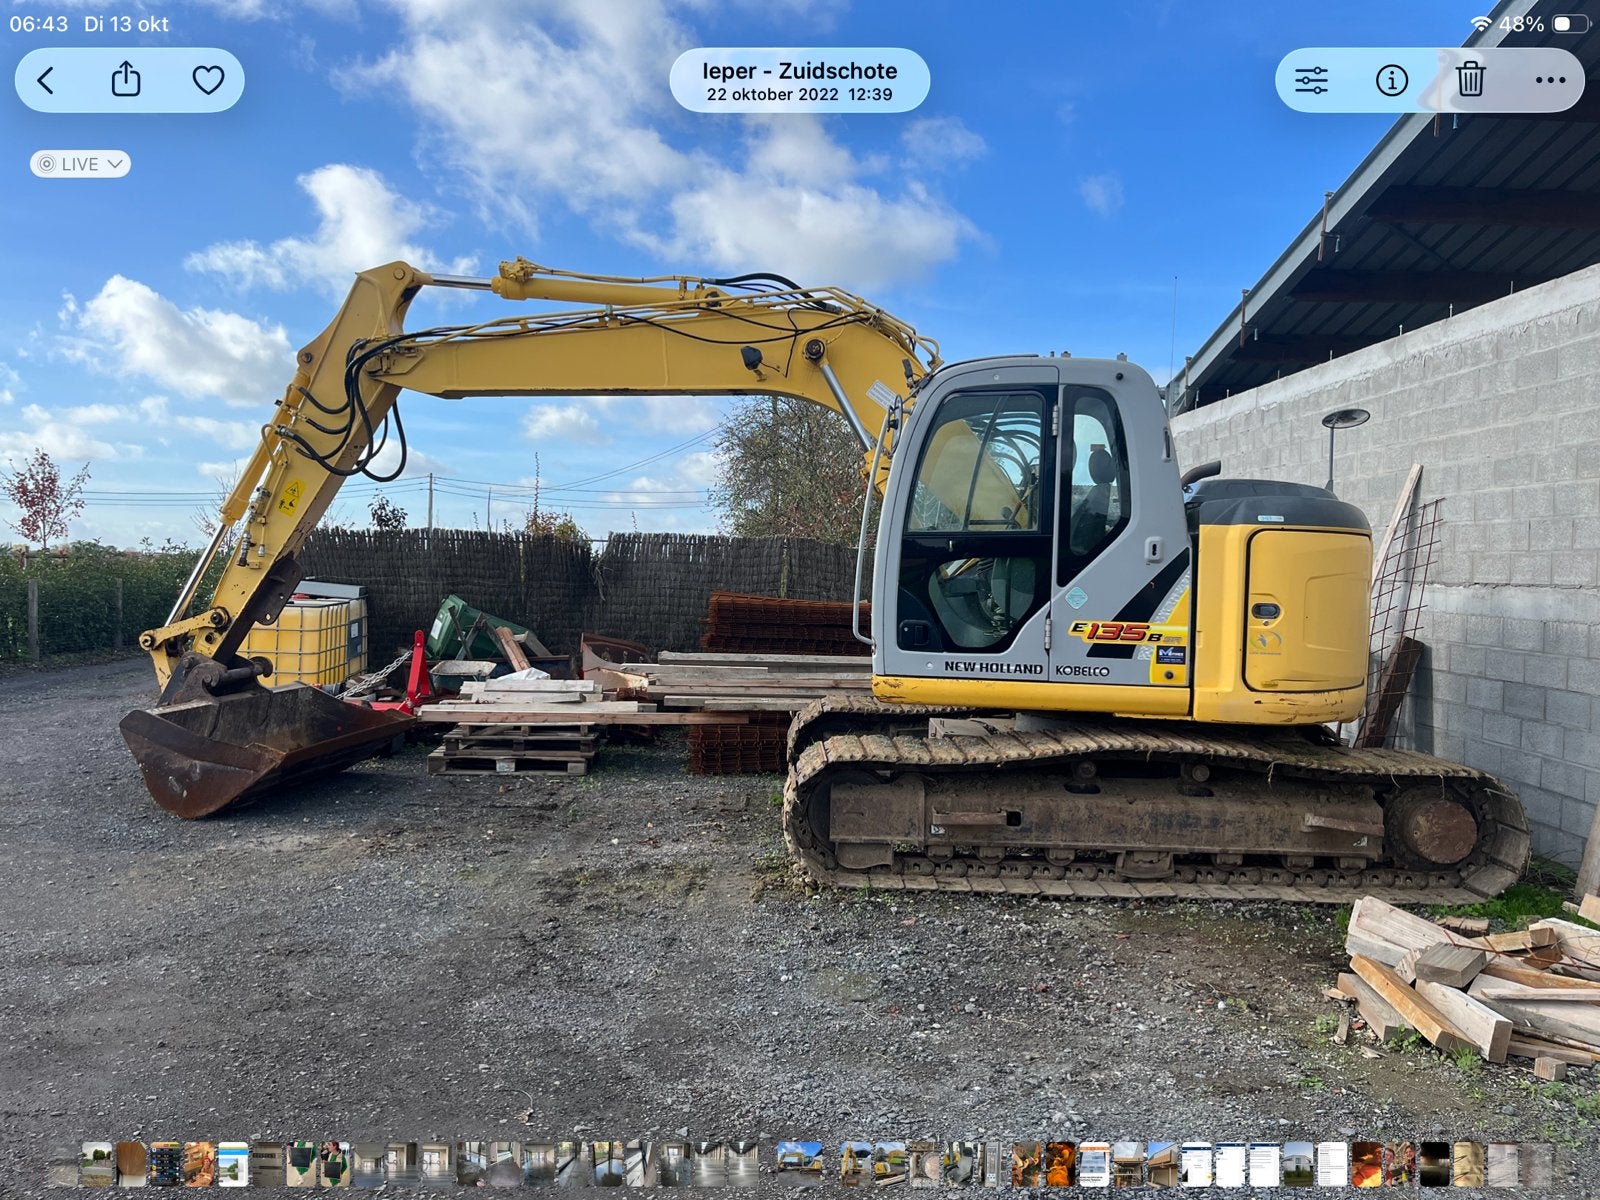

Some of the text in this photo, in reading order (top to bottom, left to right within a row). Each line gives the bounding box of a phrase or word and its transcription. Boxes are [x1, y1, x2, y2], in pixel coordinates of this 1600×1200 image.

[944, 661, 1044, 675] NEW HOLLAND
[1055, 665, 1110, 677] KOBELCO
